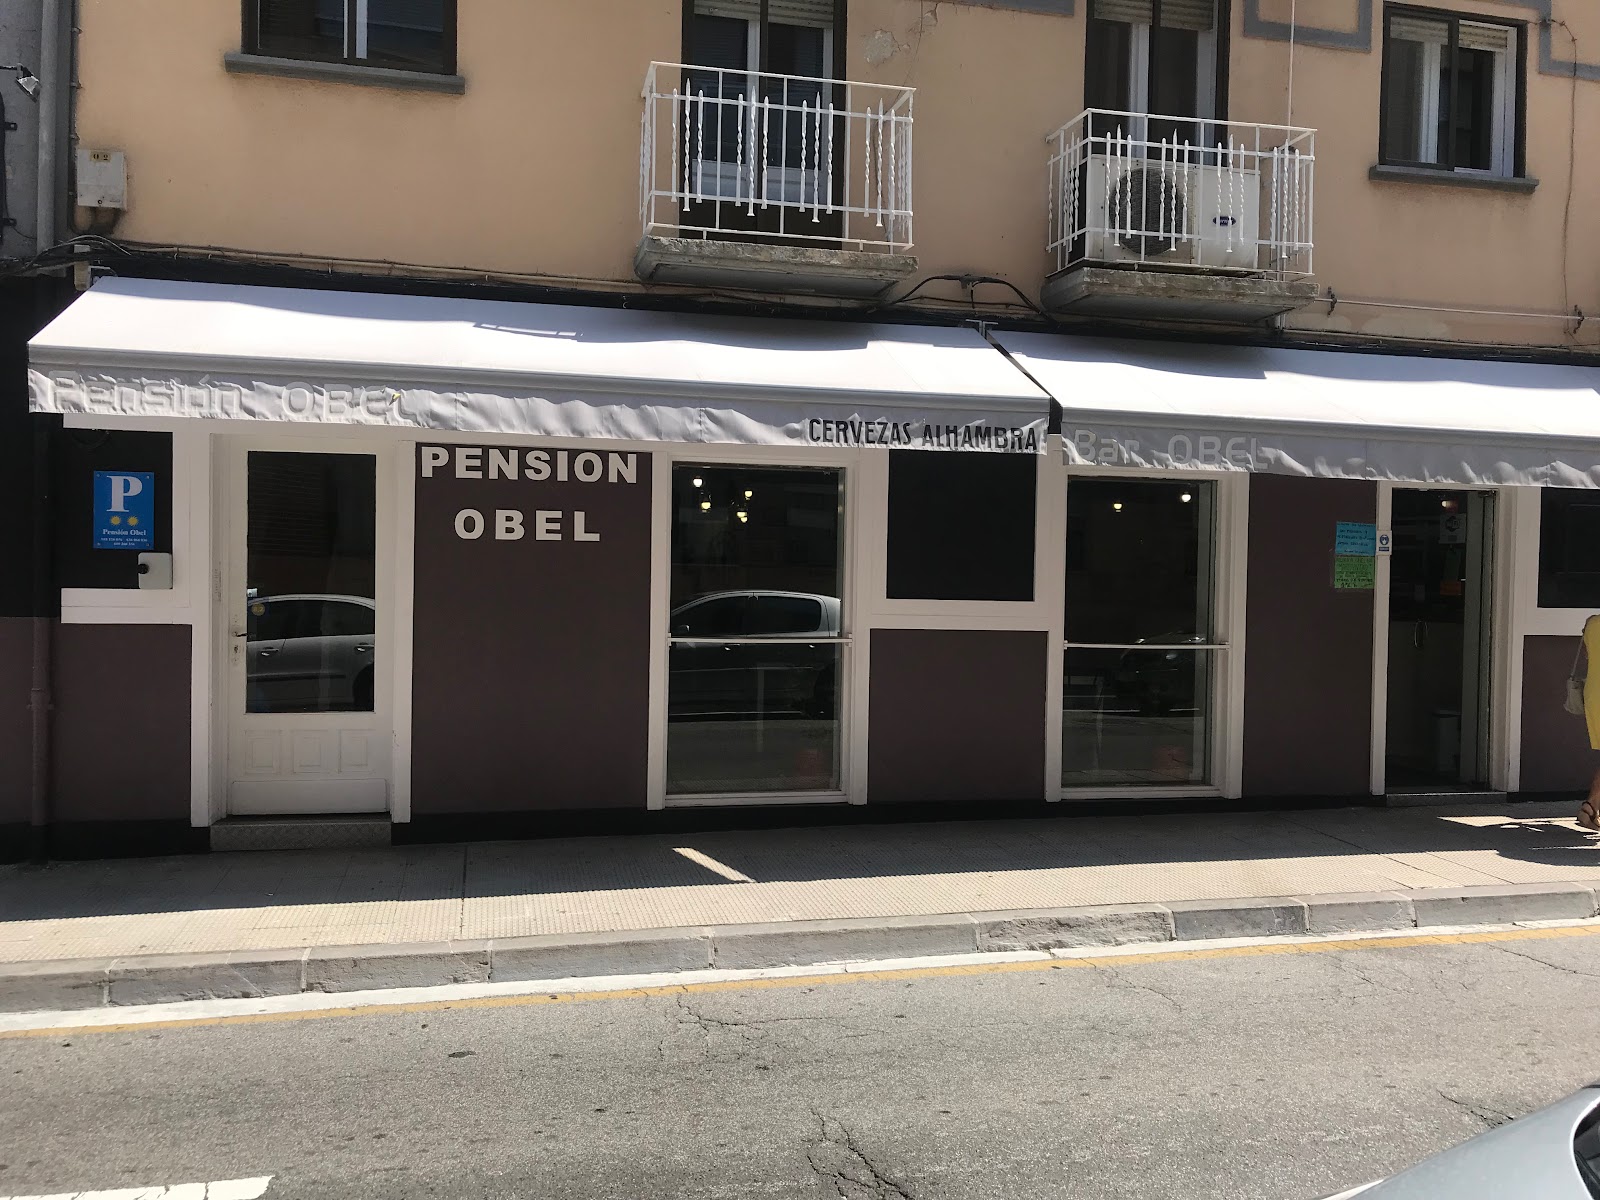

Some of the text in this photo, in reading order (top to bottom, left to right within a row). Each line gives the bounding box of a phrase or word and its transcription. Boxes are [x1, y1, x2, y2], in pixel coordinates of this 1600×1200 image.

[47, 369, 417, 427] Pensión OBEL
[808, 418, 1040, 453] CERVEZAS ALHAMBRA
[1073, 428, 1269, 470] Bar OBEL
[420, 445, 638, 485] PENSION
[106, 475, 143, 513] P
[102, 528, 129, 536] Pensión
[454, 508, 601, 543] OBEL
